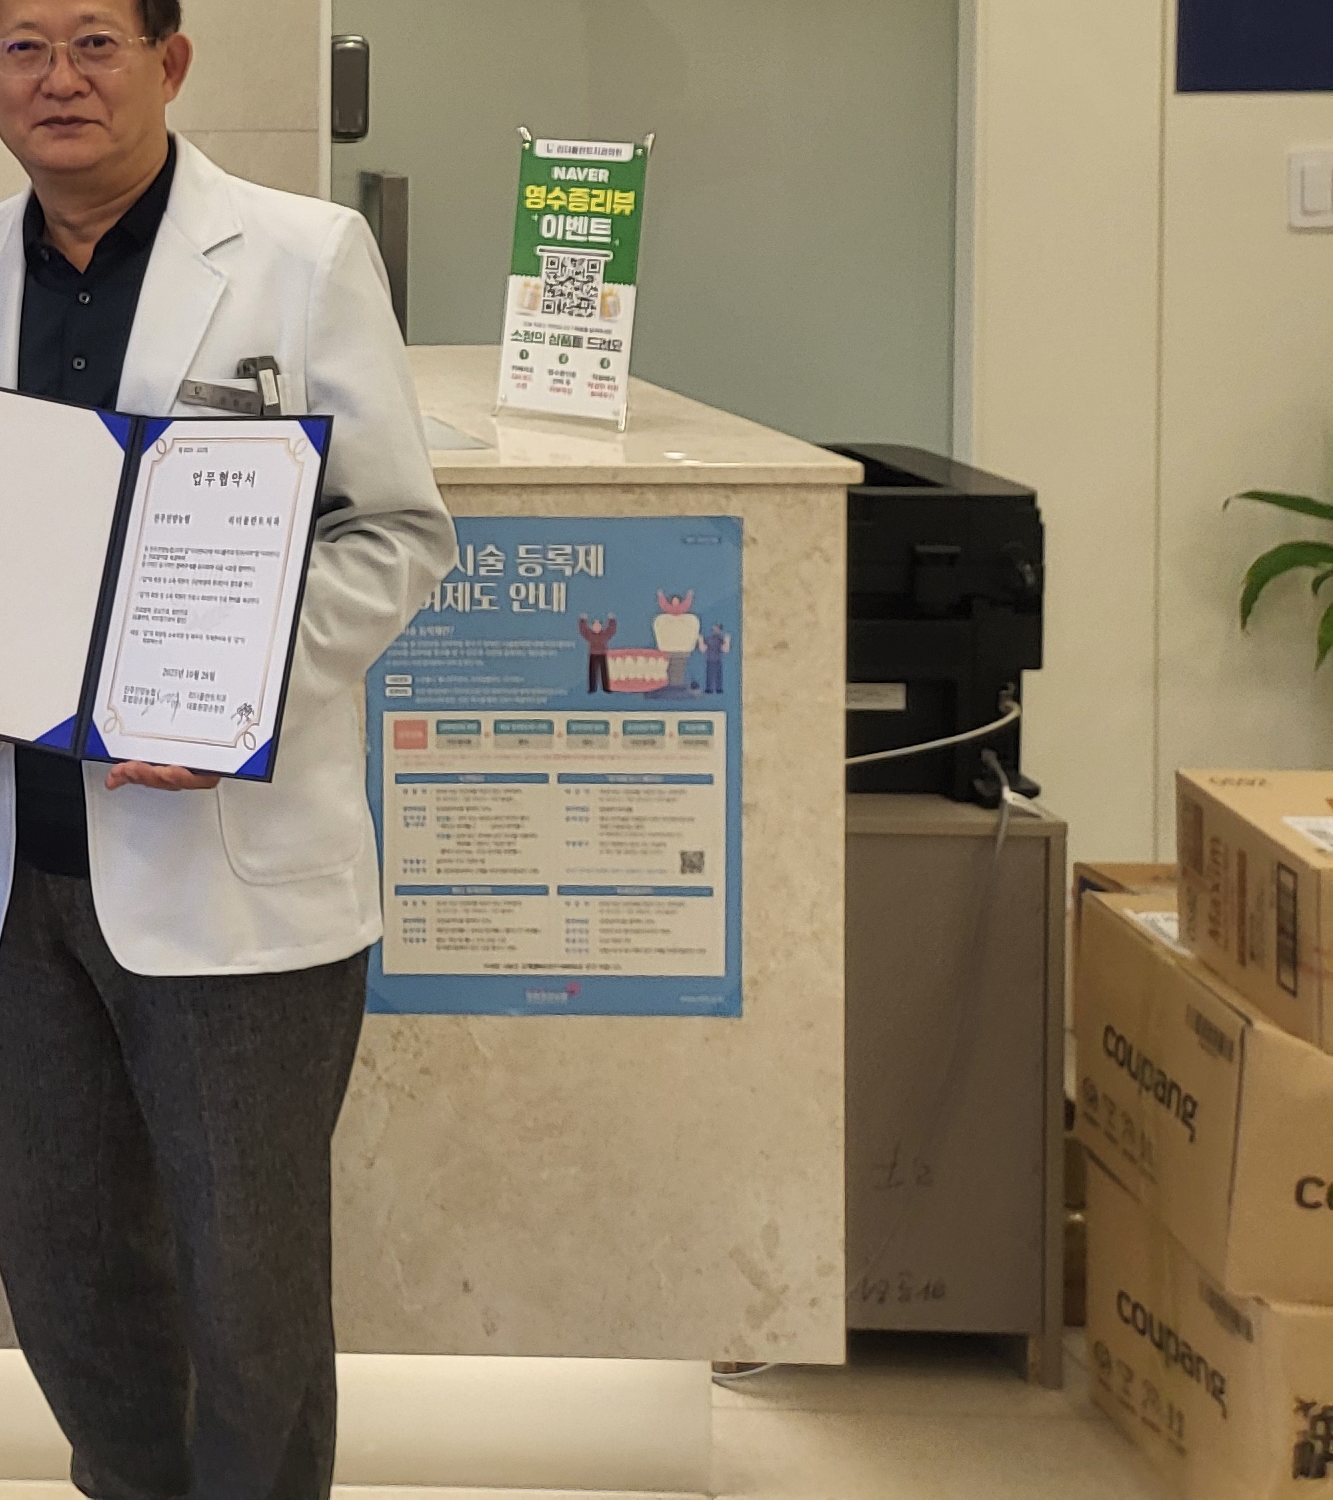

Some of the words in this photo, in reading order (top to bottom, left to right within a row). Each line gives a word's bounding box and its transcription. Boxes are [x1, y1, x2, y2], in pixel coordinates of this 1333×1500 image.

[551, 165, 610, 184] NAVER
[524, 184, 635, 216] 영수증리뷰
[541, 213, 613, 243] 이벤트
[192, 470, 256, 488] 업무협약서
[516, 543, 606, 578] 등록제
[508, 581, 568, 614] 안내
[1102, 1023, 1199, 1144] coupang
[1115, 1289, 1228, 1420] coupang
